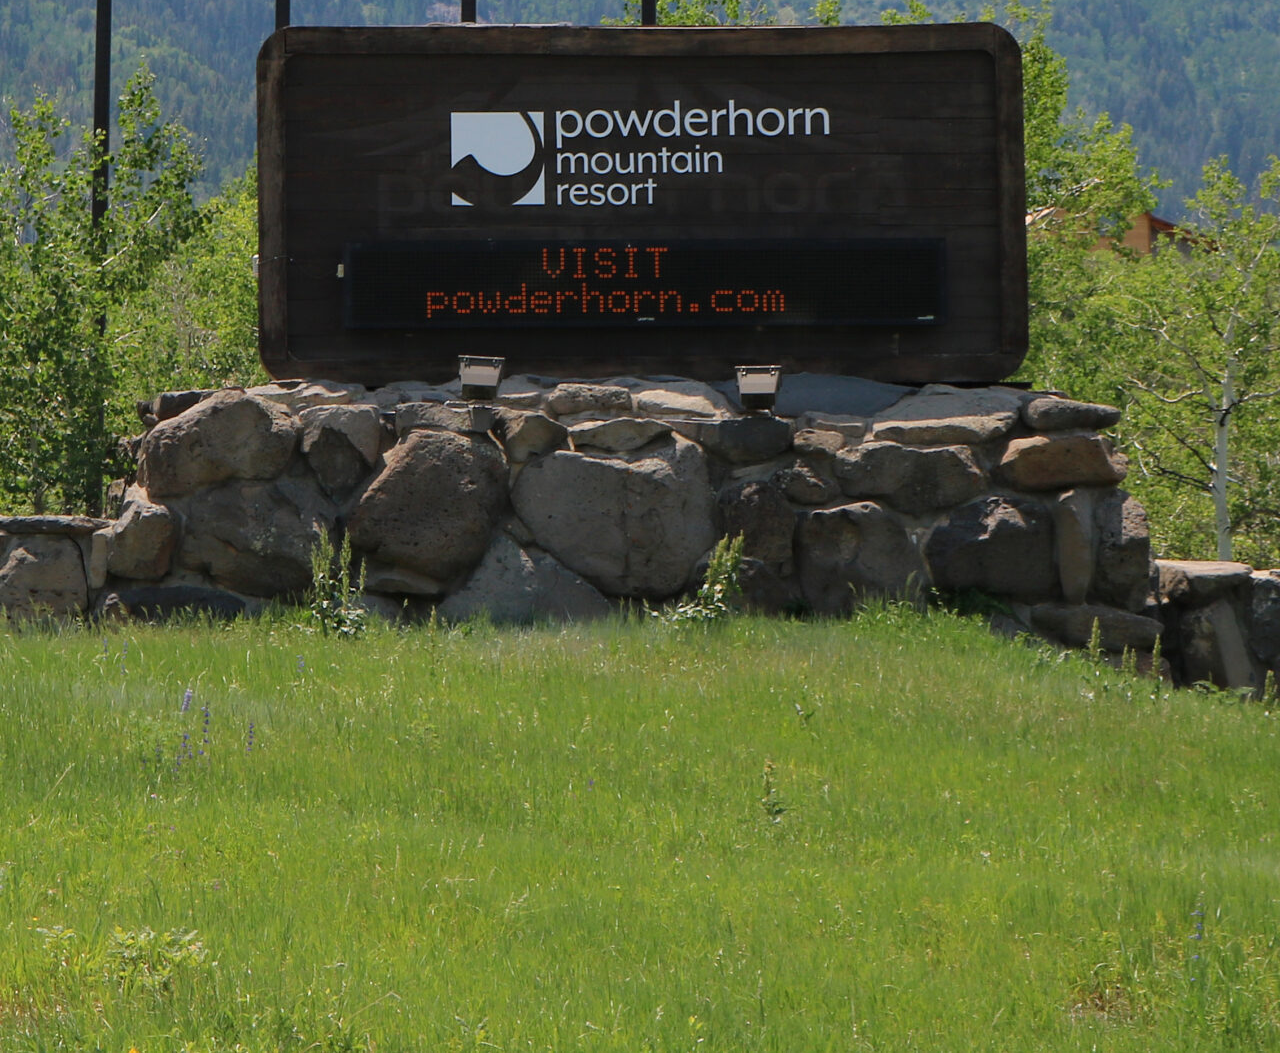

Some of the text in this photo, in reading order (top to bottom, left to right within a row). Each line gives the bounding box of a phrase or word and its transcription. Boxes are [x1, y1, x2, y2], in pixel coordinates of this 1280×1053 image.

[556, 100, 830, 148] powderhorn
[557, 145, 723, 174] mountain
[556, 178, 657, 206] resort
[543, 247, 668, 278] VISIT
[426, 283, 785, 318] powderhorn.com
